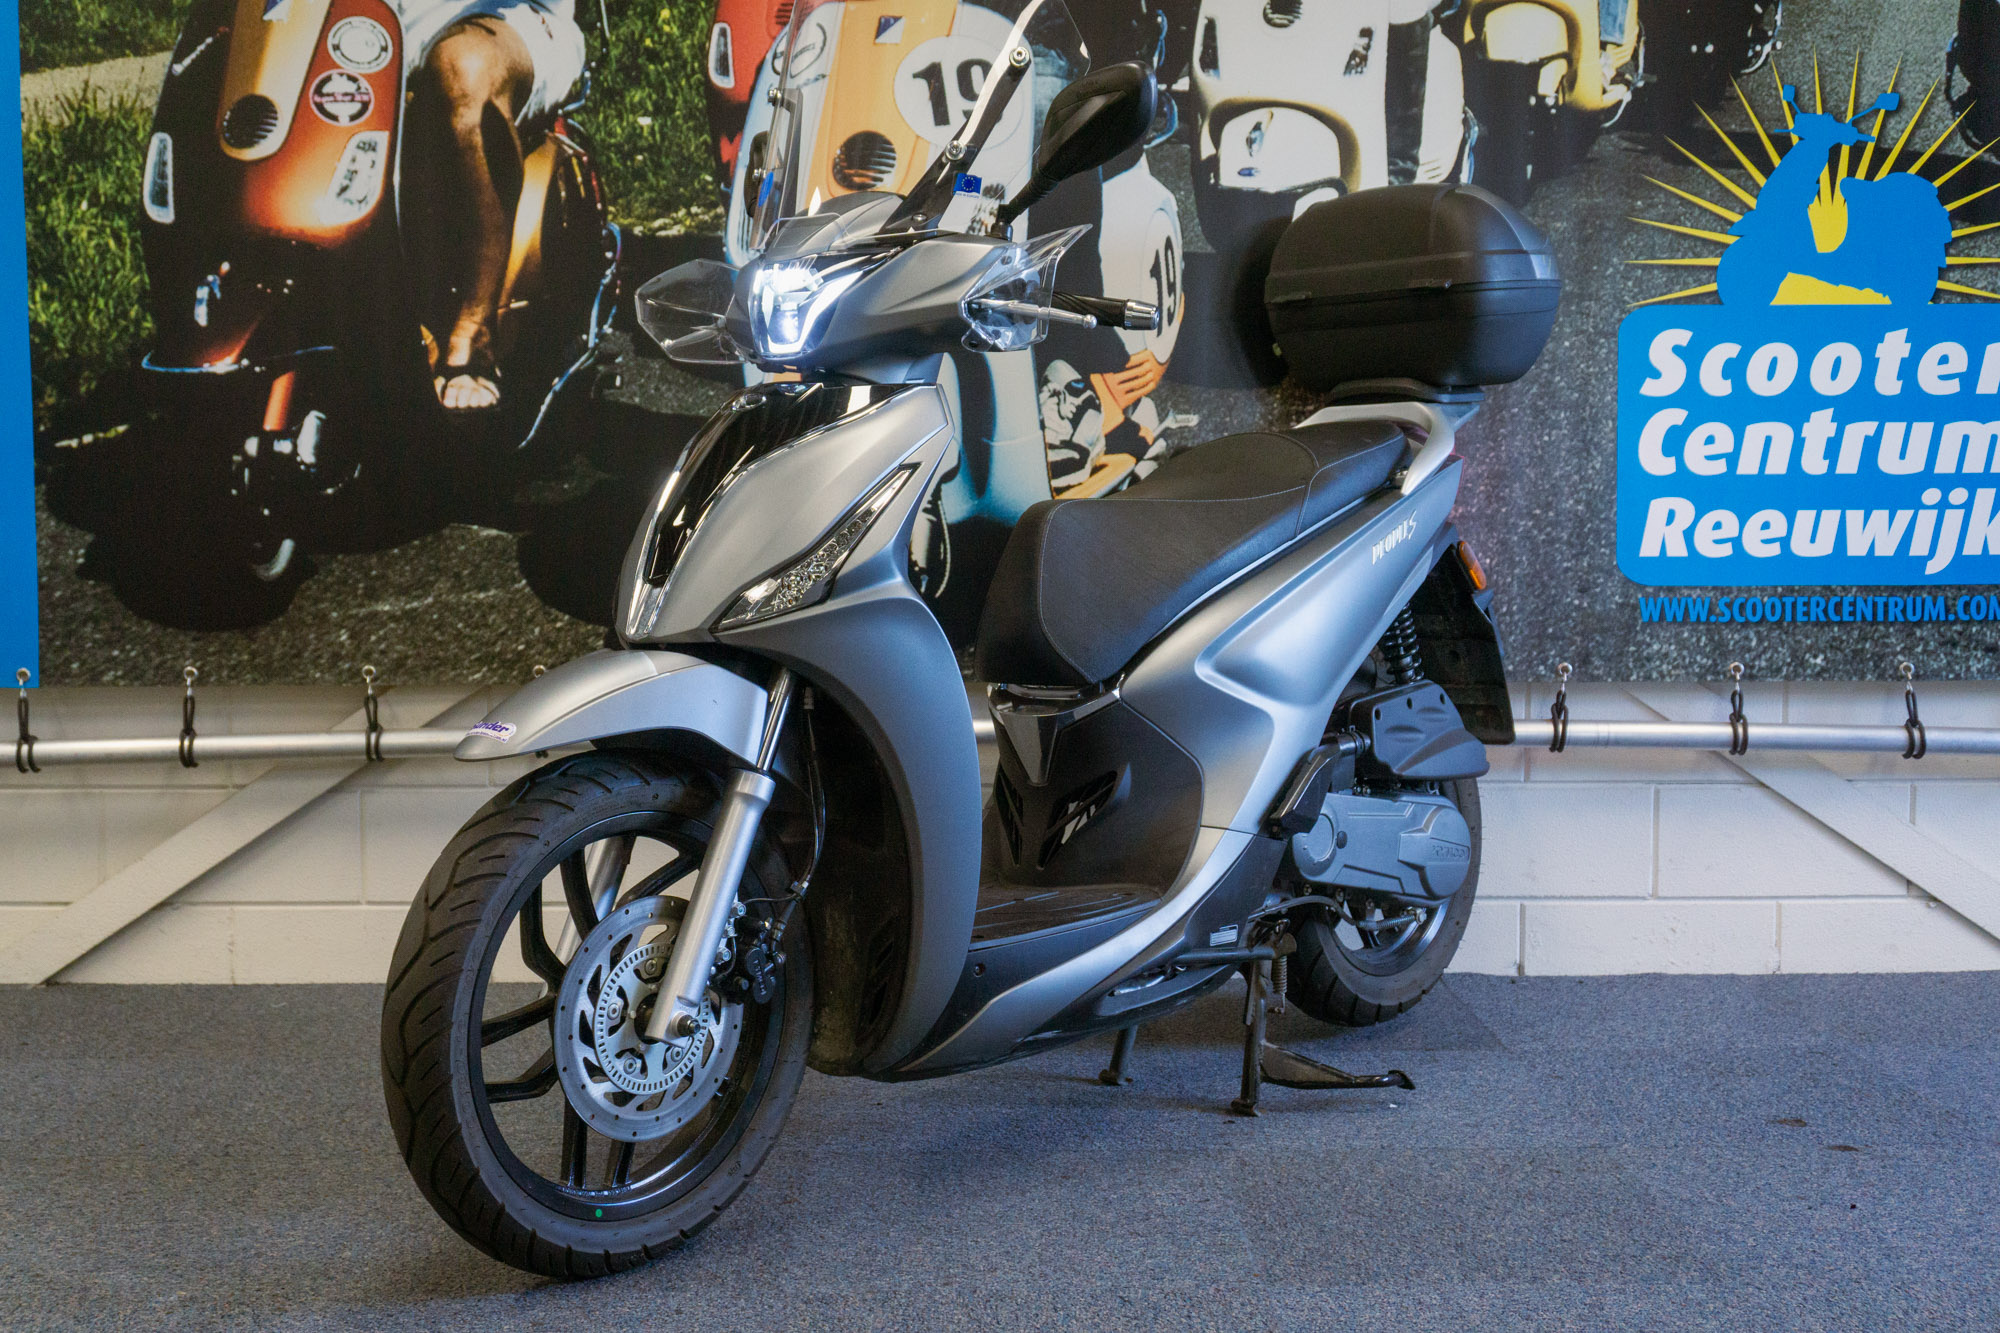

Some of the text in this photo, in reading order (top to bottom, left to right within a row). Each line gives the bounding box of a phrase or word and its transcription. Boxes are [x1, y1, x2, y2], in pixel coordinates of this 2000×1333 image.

[912, 58, 1002, 126] 19
[1149, 235, 1176, 337] 19
[1639, 328, 2000, 397] Scooter
[1638, 407, 2000, 476] Centrum
[1639, 487, 2000, 575] Reeuwijk
